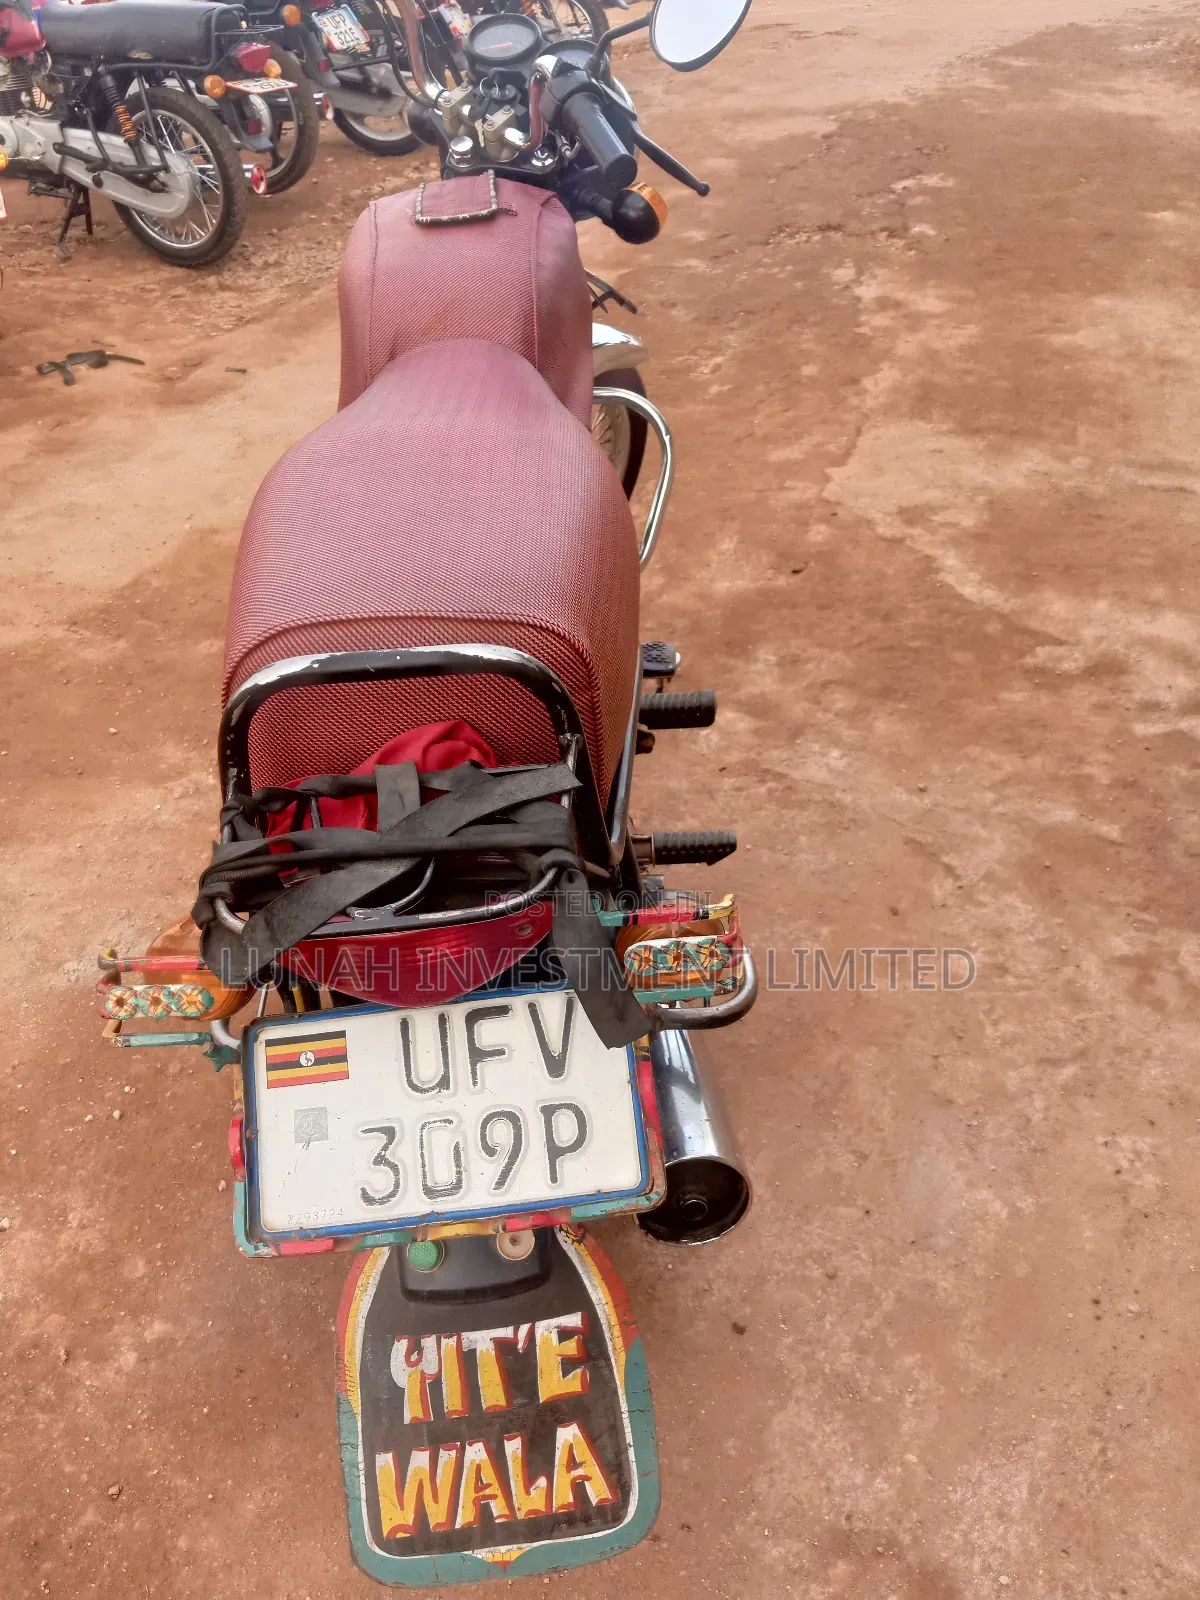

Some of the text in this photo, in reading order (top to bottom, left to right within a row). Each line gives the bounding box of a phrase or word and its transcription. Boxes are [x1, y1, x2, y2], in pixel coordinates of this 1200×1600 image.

[399, 991, 577, 1095] UFV
[359, 1101, 589, 1207] 309P
[375, 1421, 620, 1541] WALA
